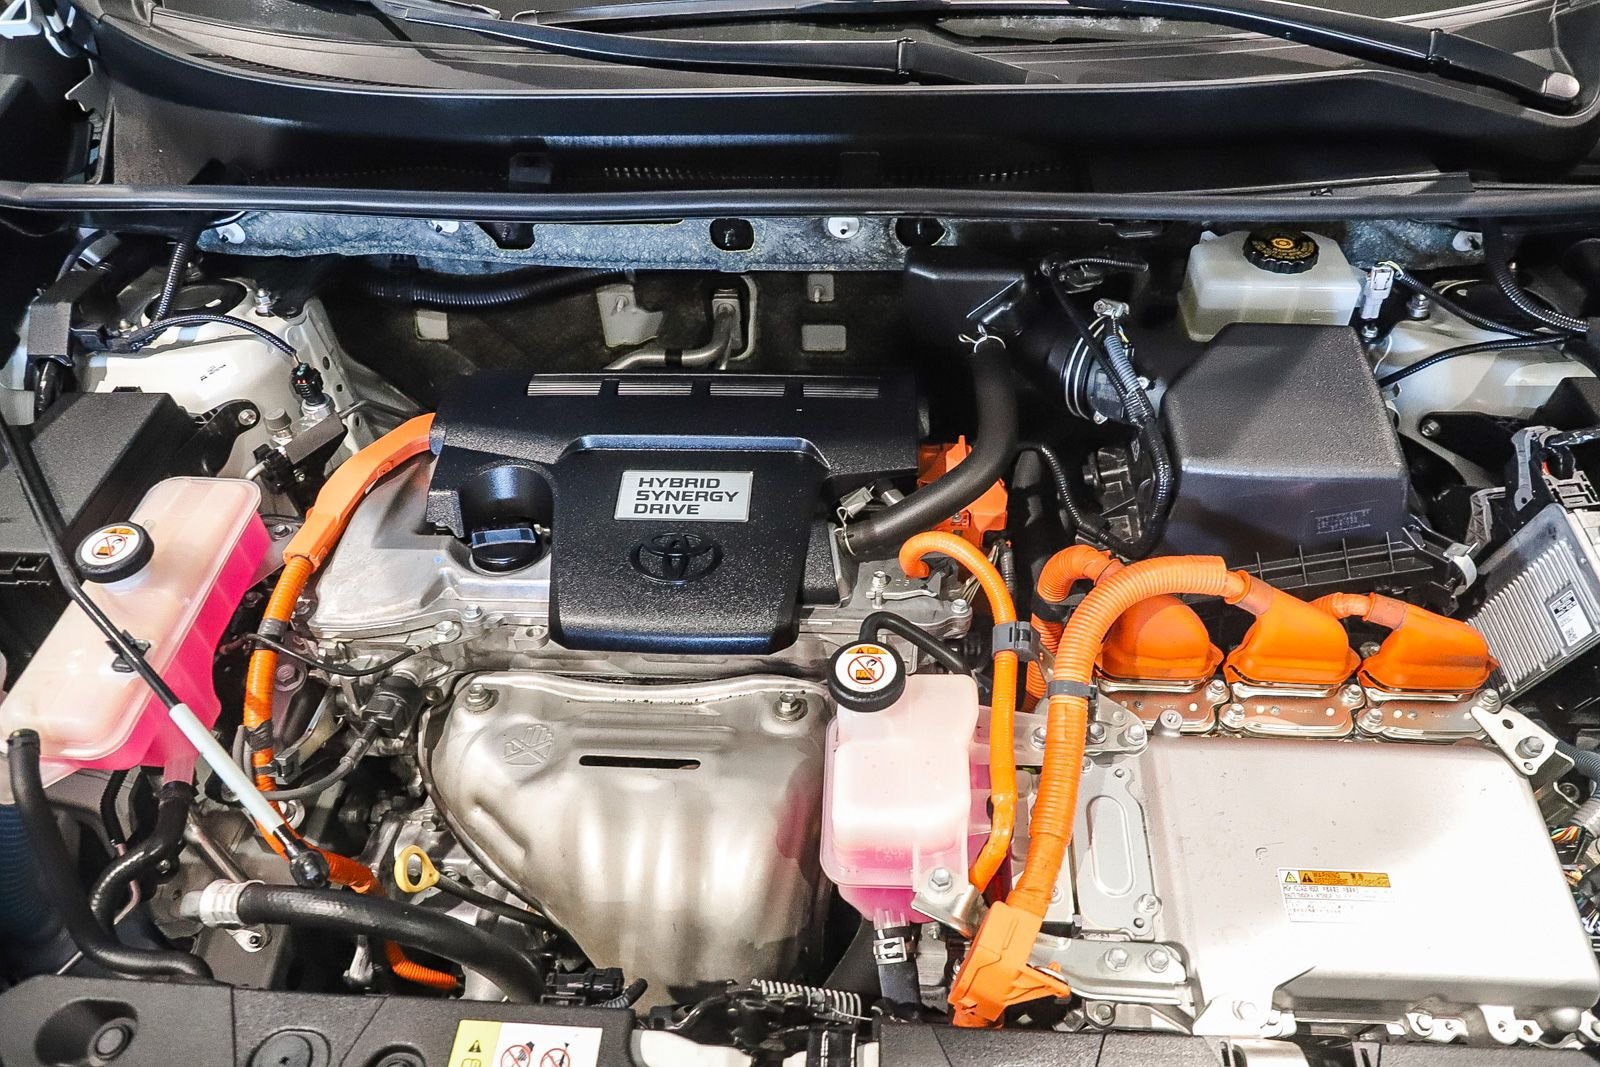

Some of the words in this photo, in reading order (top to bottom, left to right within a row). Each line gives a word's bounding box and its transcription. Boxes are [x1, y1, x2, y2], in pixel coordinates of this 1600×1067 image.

[638, 477, 721, 489] HYBRID
[635, 490, 740, 502] SYNERGY
[633, 503, 701, 515] DRIVE
